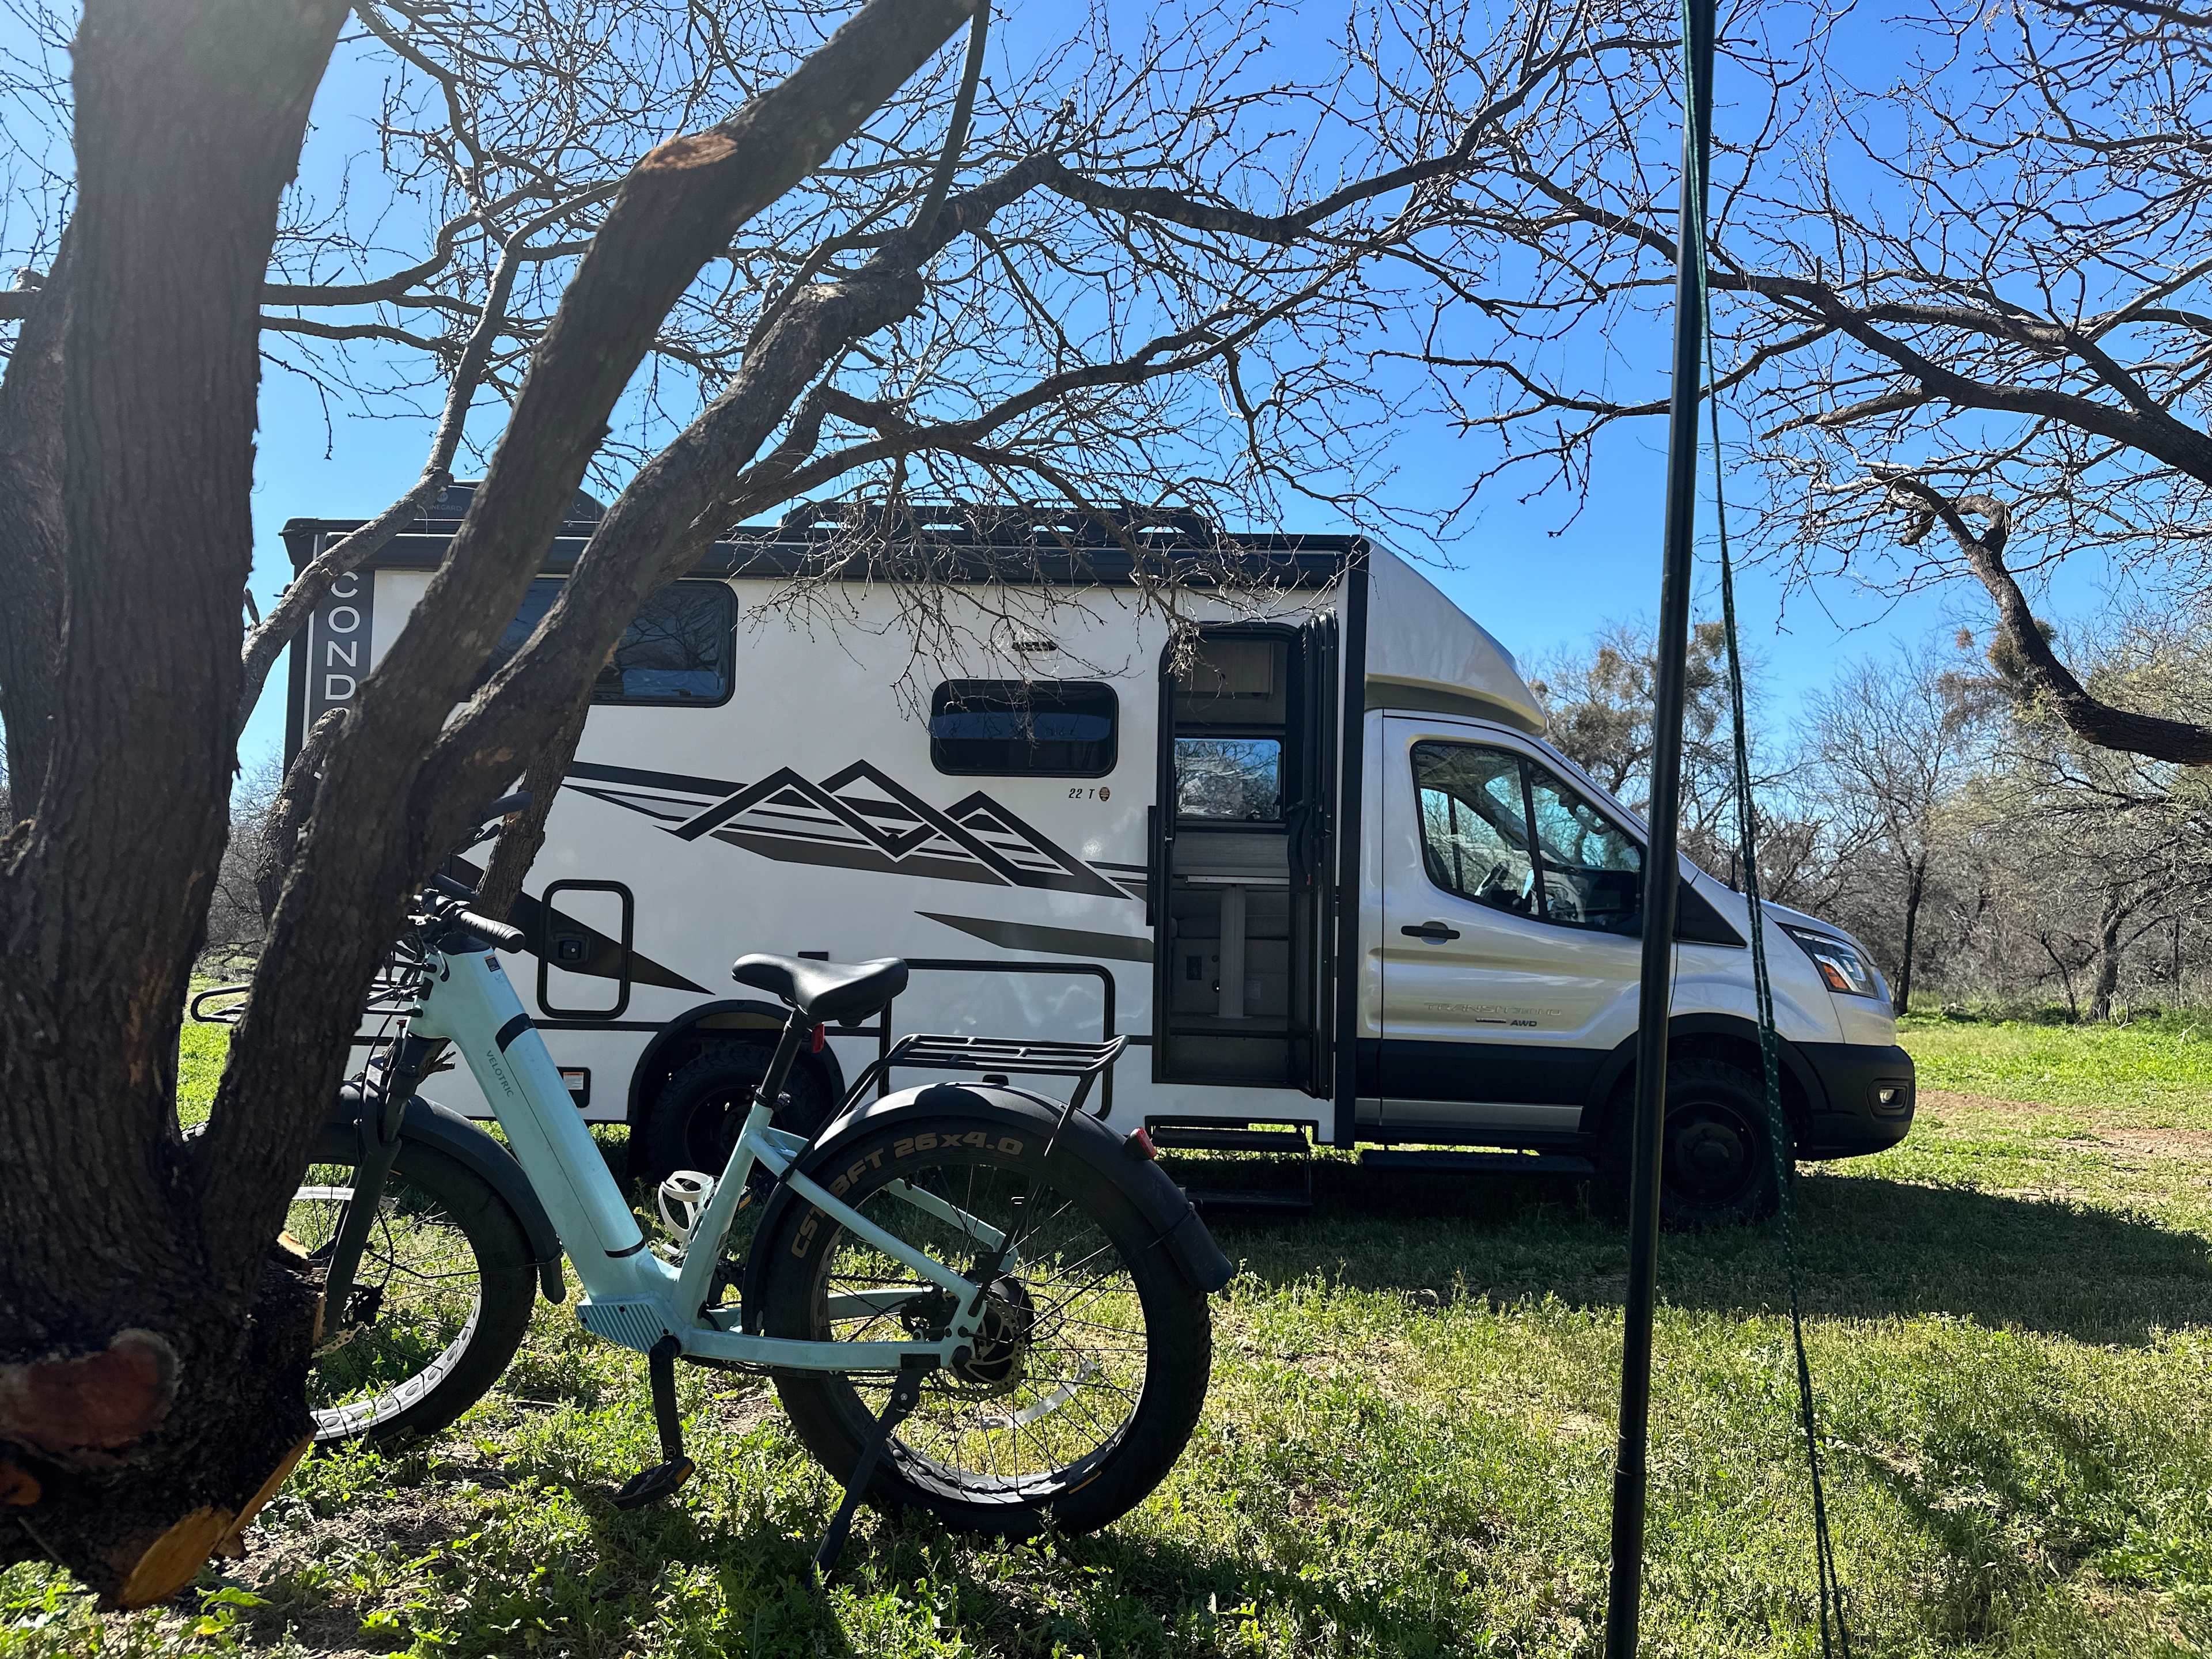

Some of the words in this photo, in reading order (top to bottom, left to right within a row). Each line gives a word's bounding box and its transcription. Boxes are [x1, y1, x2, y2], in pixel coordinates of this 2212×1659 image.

[324, 571, 360, 710] COND
[1069, 788, 1082, 798] 22
[1089, 789, 1095, 799] T
[486, 1050, 514, 1097] VELOTRIC
[828, 1147, 884, 1198] BFT
[893, 1131, 1024, 1158] 26x4.0
